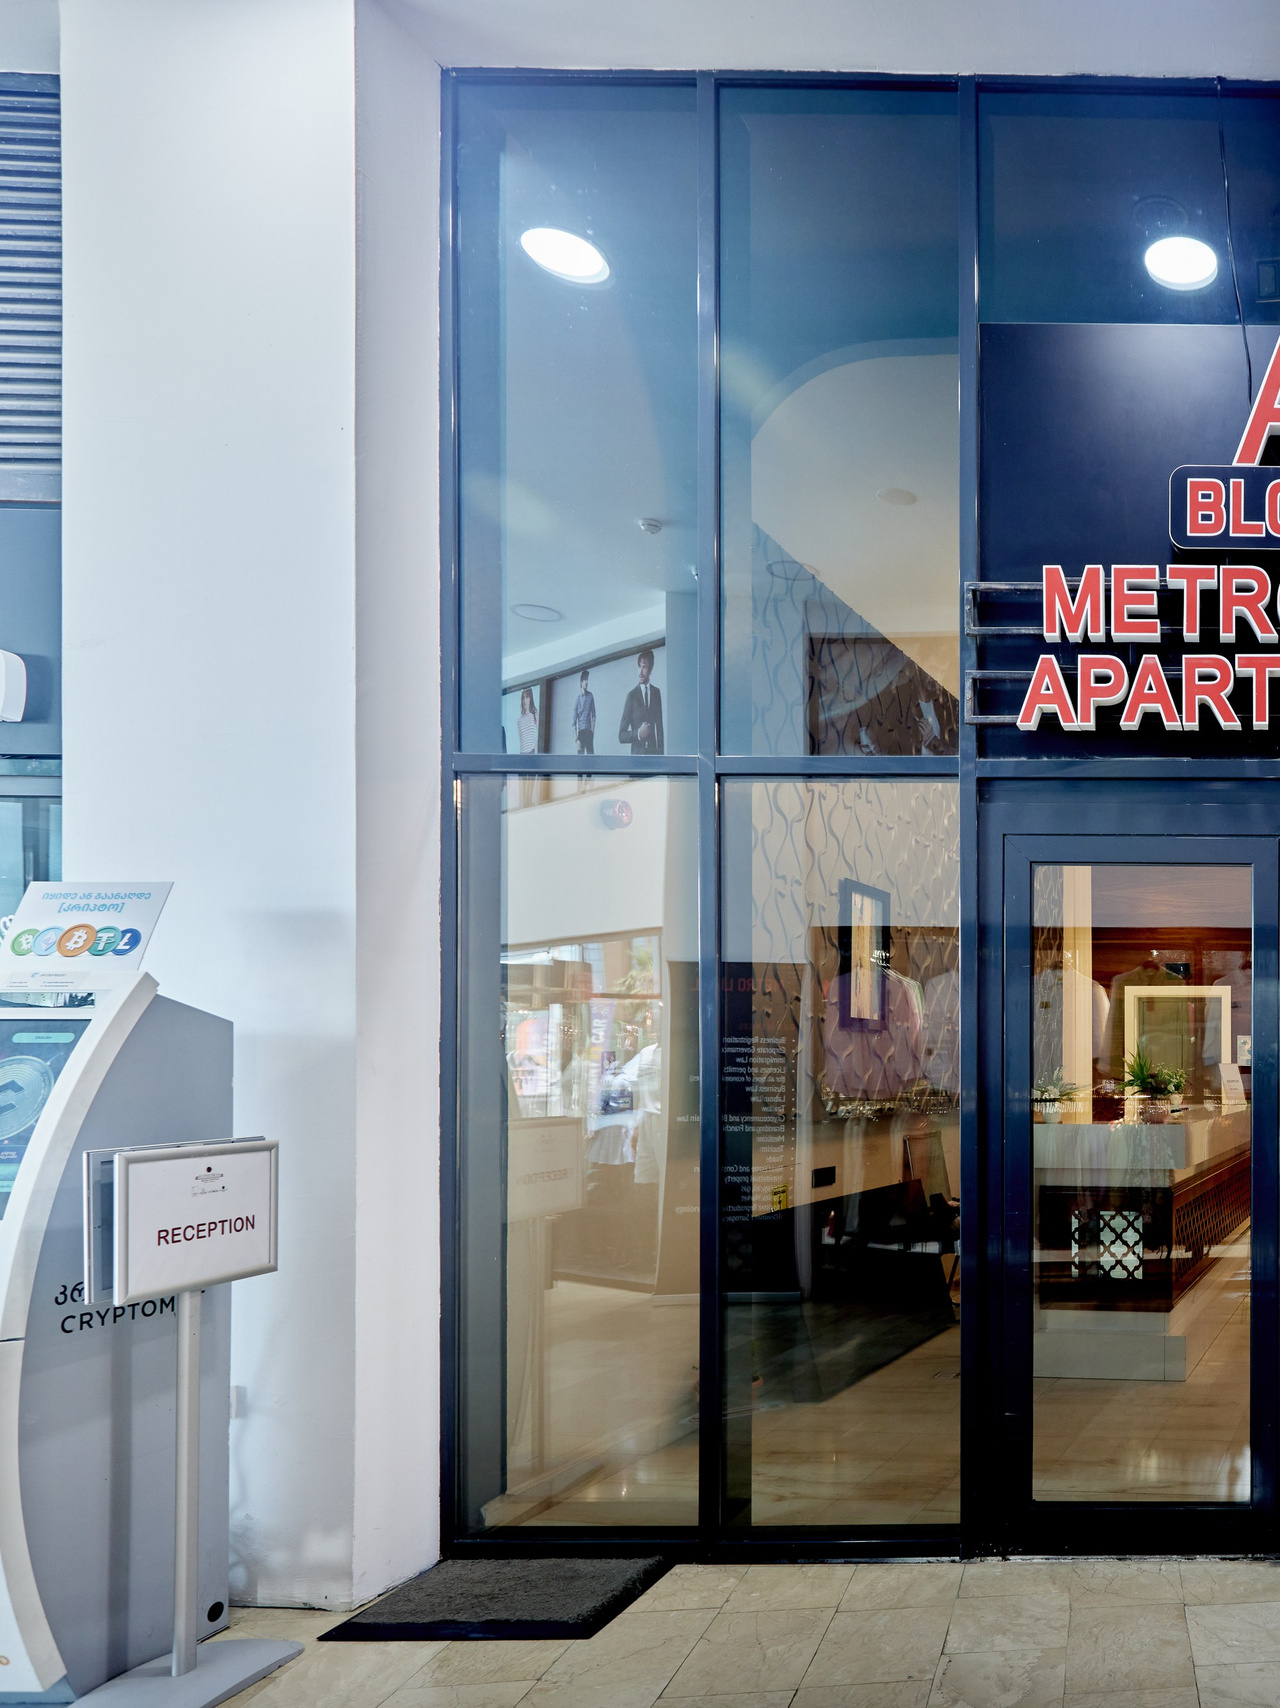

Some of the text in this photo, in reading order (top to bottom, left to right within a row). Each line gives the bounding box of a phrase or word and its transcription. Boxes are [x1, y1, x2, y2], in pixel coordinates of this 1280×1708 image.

[42, 892, 78, 900] იყიდე
[80, 892, 93, 900] ან
[157, 1214, 255, 1246] RECEPTION
[60, 1296, 177, 1334] CRYPTOM
